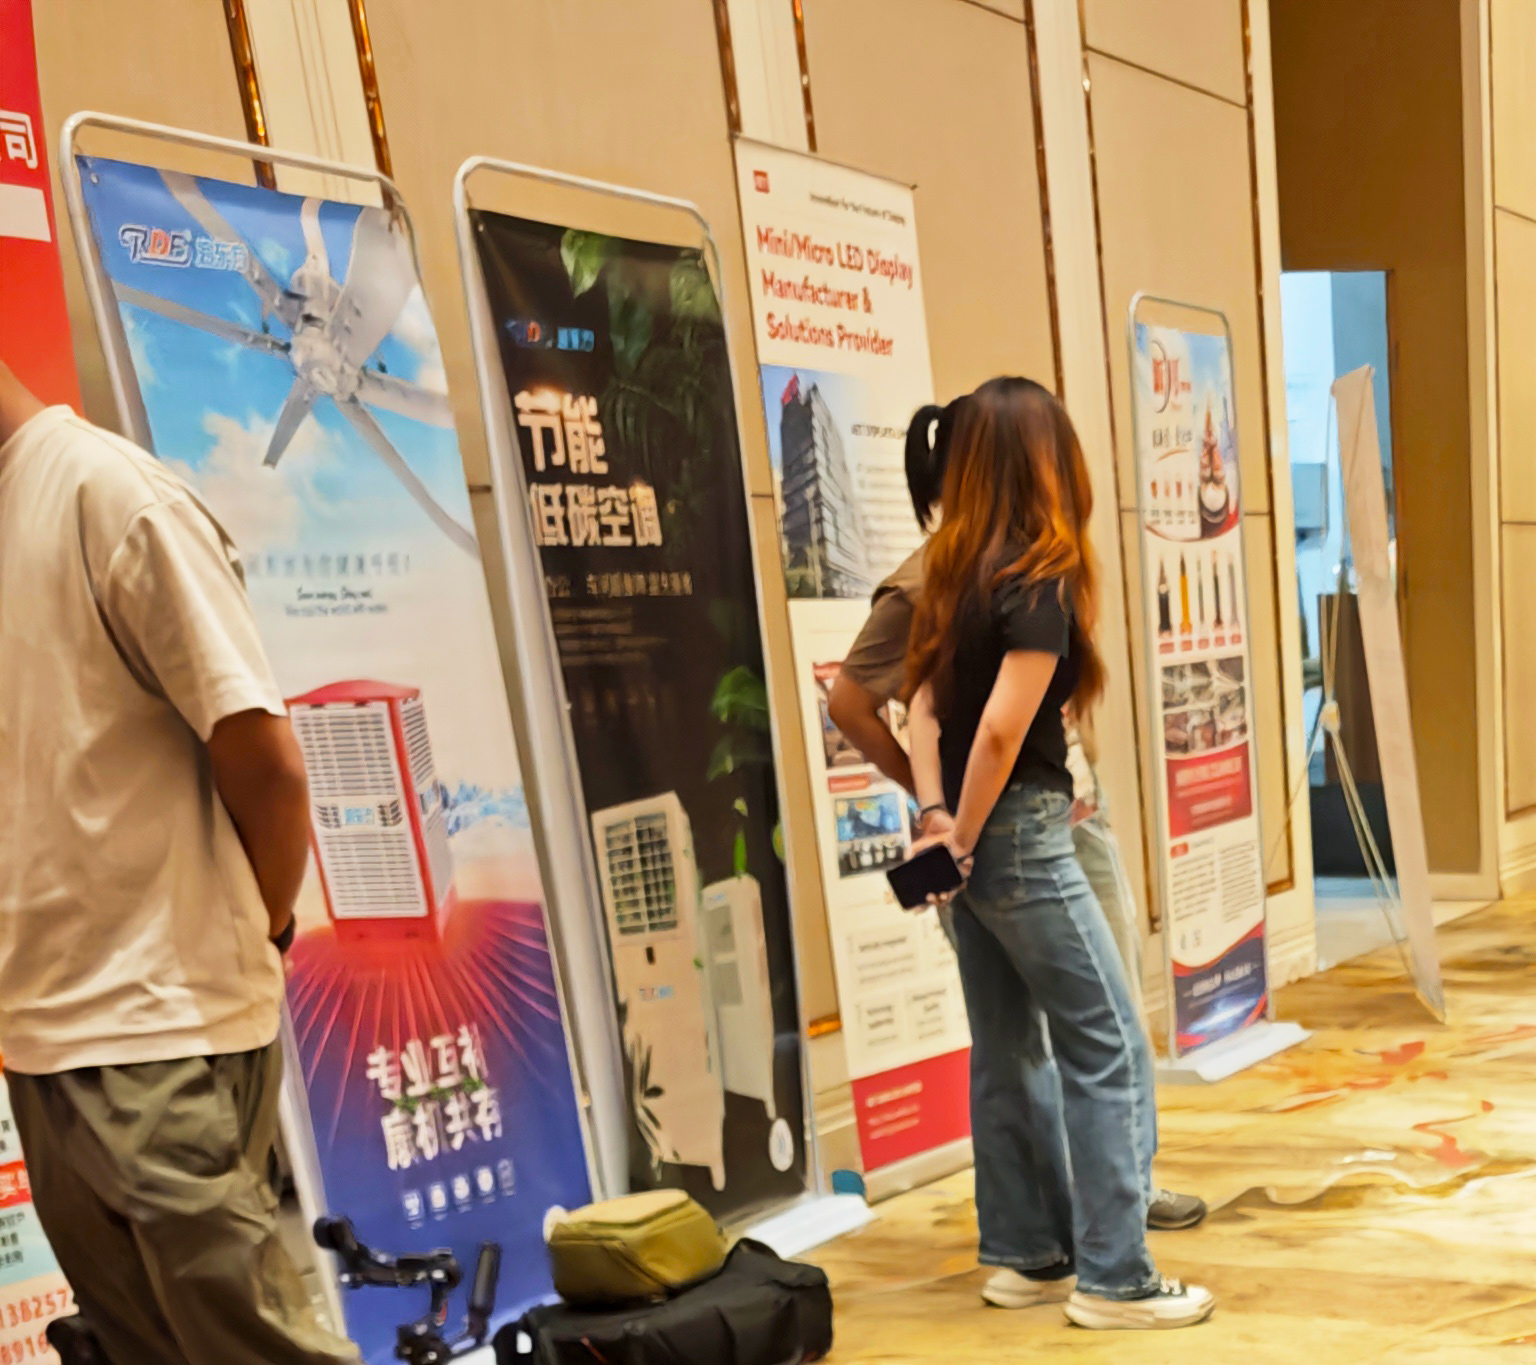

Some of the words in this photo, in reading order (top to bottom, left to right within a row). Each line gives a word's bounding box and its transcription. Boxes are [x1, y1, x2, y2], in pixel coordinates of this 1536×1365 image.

[756, 225, 834, 267] Mini/Micro
[836, 242, 864, 272] LED
[867, 248, 914, 290] Display
[761, 268, 858, 311] Manufacturer
[765, 311, 835, 348] Solutions
[836, 323, 894, 357] Provider
[514, 389, 609, 474] 节能
